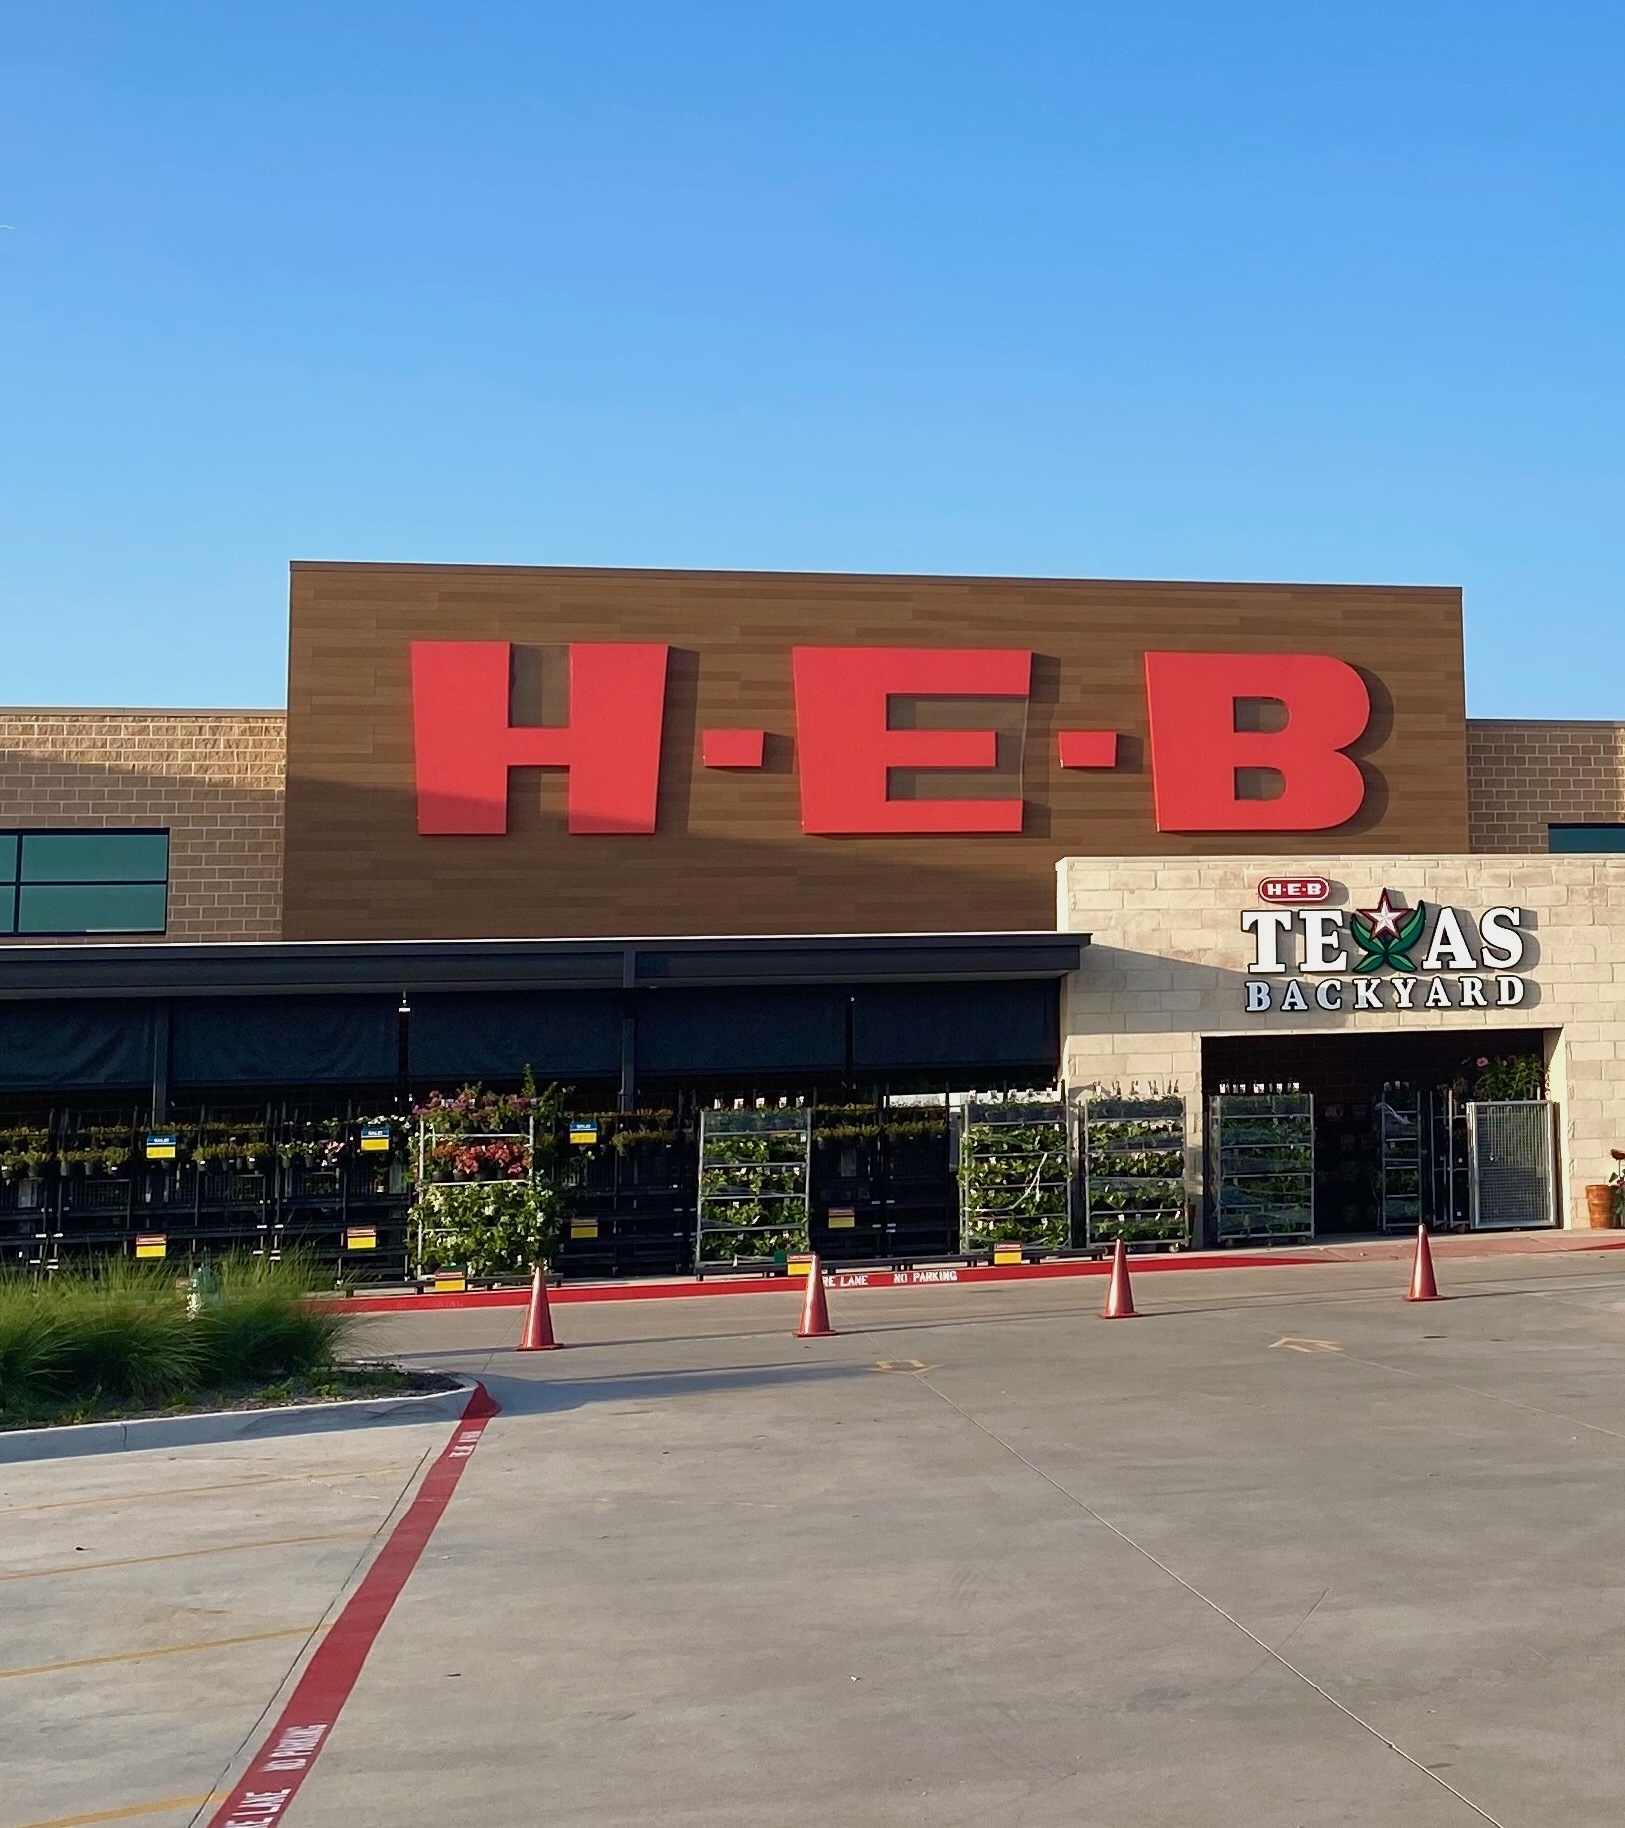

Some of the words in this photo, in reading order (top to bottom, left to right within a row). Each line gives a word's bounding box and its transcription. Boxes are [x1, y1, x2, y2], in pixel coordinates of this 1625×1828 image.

[411, 641, 1370, 834] H-E-B
[1265, 881, 1324, 897] H-E-B
[1241, 888, 1524, 973] TEXAS
[1245, 975, 1524, 1011] BACKYARD
[840, 1274, 869, 1287] LANE
[893, 1272, 907, 1284] NO
[912, 1270, 958, 1283] PARKING
